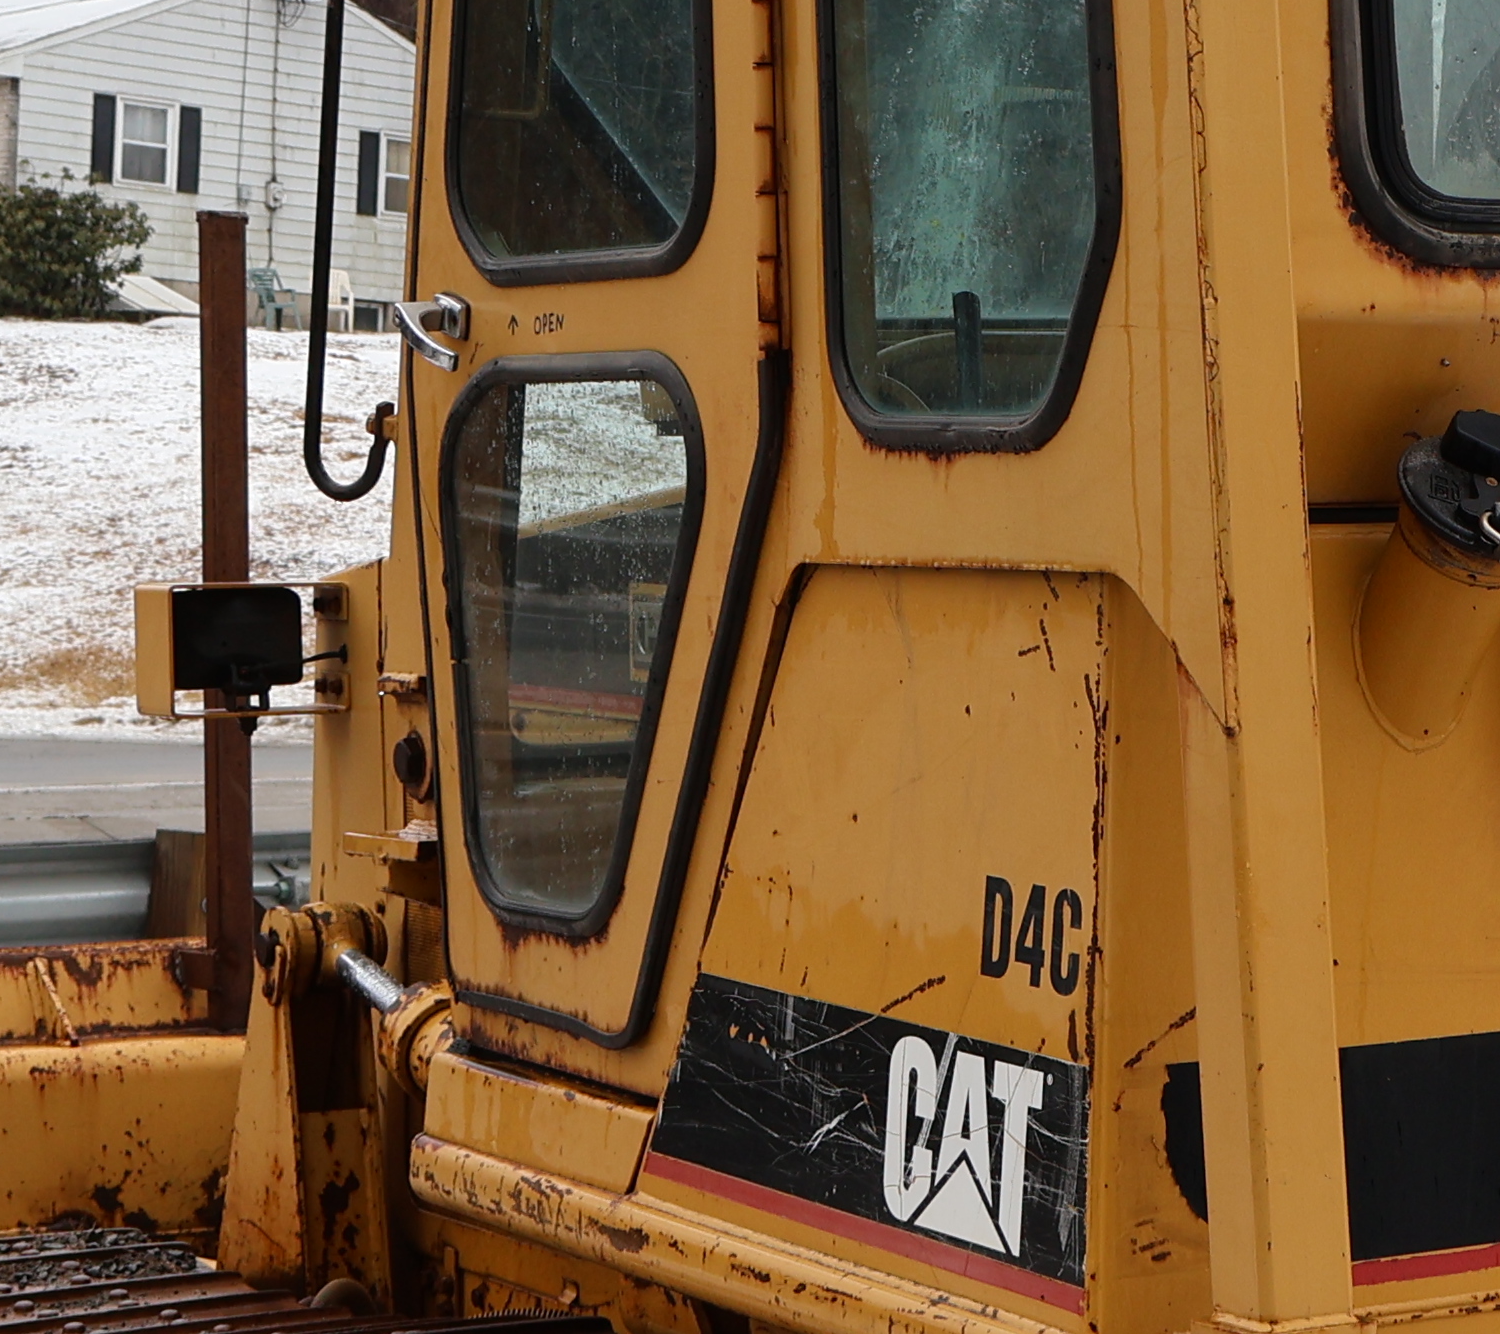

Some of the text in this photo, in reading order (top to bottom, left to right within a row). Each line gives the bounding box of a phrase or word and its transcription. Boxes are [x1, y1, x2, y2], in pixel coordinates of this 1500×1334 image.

[534, 313, 564, 335] OPEN
[980, 875, 1082, 996] D4C
[883, 1035, 1046, 1258] CAT
